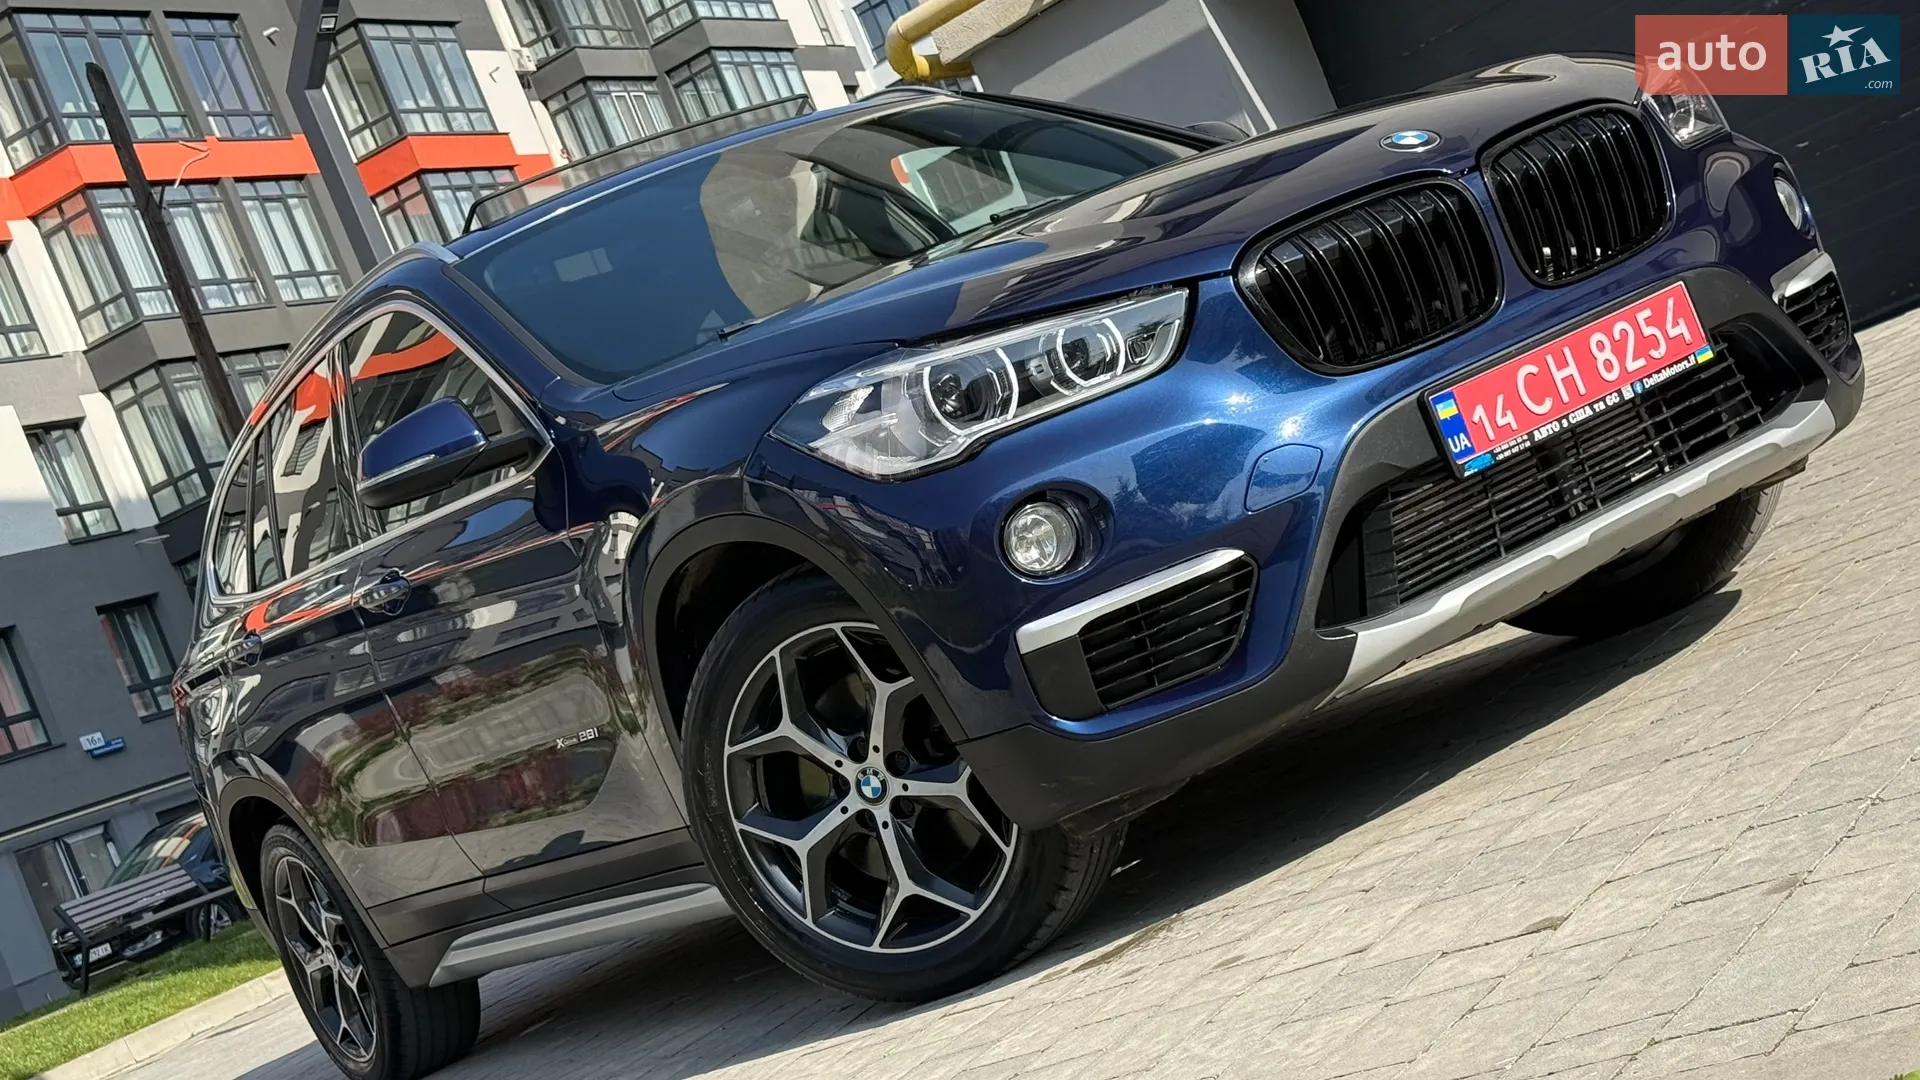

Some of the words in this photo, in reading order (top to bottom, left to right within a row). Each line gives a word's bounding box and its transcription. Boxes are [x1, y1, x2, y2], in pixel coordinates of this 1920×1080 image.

[1471, 394, 1518, 442] 14
[1517, 346, 1587, 414] CH
[1589, 297, 1692, 382] 8254
[1533, 423, 1560, 441] АВТО
[1448, 433, 1471, 453] UA
[857, 768, 885, 781] BMW
